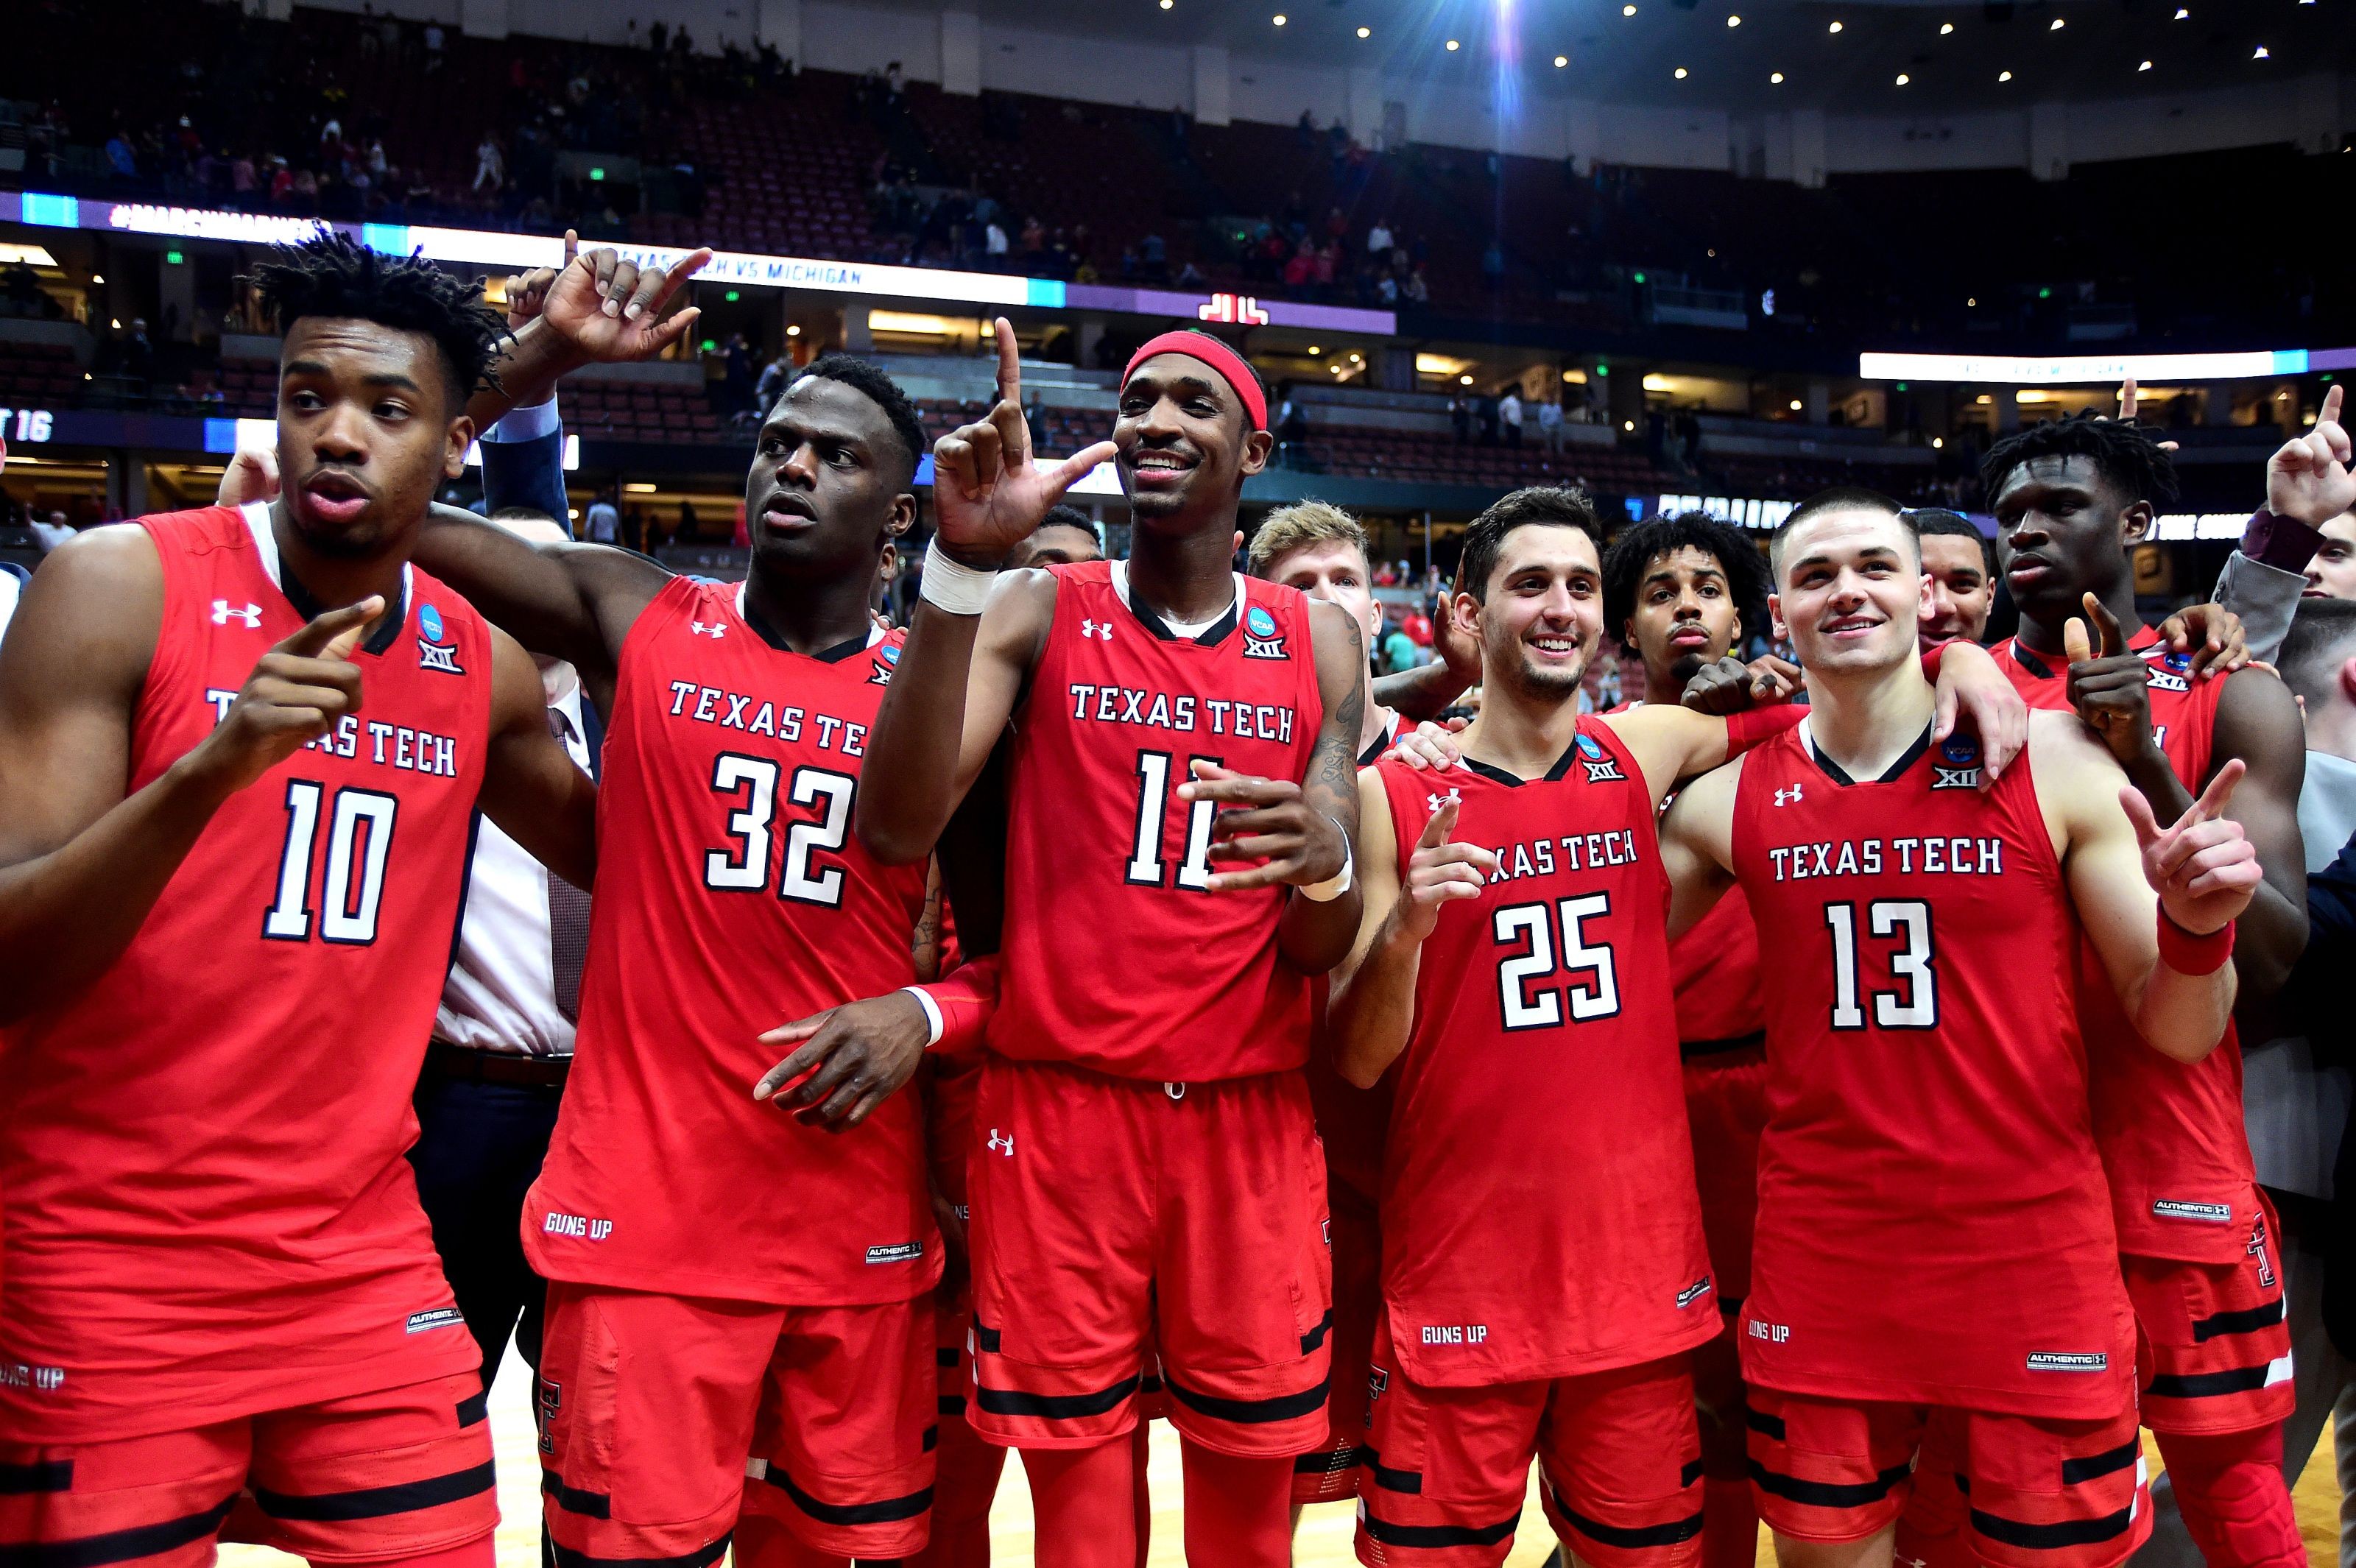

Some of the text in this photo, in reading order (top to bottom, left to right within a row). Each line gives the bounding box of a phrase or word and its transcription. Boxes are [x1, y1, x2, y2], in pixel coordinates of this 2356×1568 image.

[737, 261, 758, 278] VS
[16, 409, 53, 442] 16
[417, 638, 464, 671] XII
[1244, 632, 1288, 658] XII
[669, 679, 868, 757] TEXAS TE
[1069, 683, 1295, 744] TEXAS TECH
[367, 719, 456, 777] TECH
[1581, 760, 1626, 782] XII
[1932, 766, 1982, 788] XII
[705, 752, 857, 909] 32
[1126, 749, 1224, 893] 11
[263, 778, 399, 946] 10
[1471, 829, 1638, 886] XAS TECH
[1768, 837, 2002, 881] TEXAS TECH
[1492, 890, 1622, 1032] 25
[1824, 899, 1939, 1031] 13
[2156, 1201, 2213, 1213] AUTHENTIC
[545, 1212, 613, 1240] GUNS UP
[869, 1246, 910, 1256] AUTHENTC
[1422, 1324, 1488, 1344] GUNS UP
[1771, 1324, 1790, 1343] UP
[2031, 1354, 2094, 1363] AUTHENTIC
[35, 1367, 65, 1389] UP
